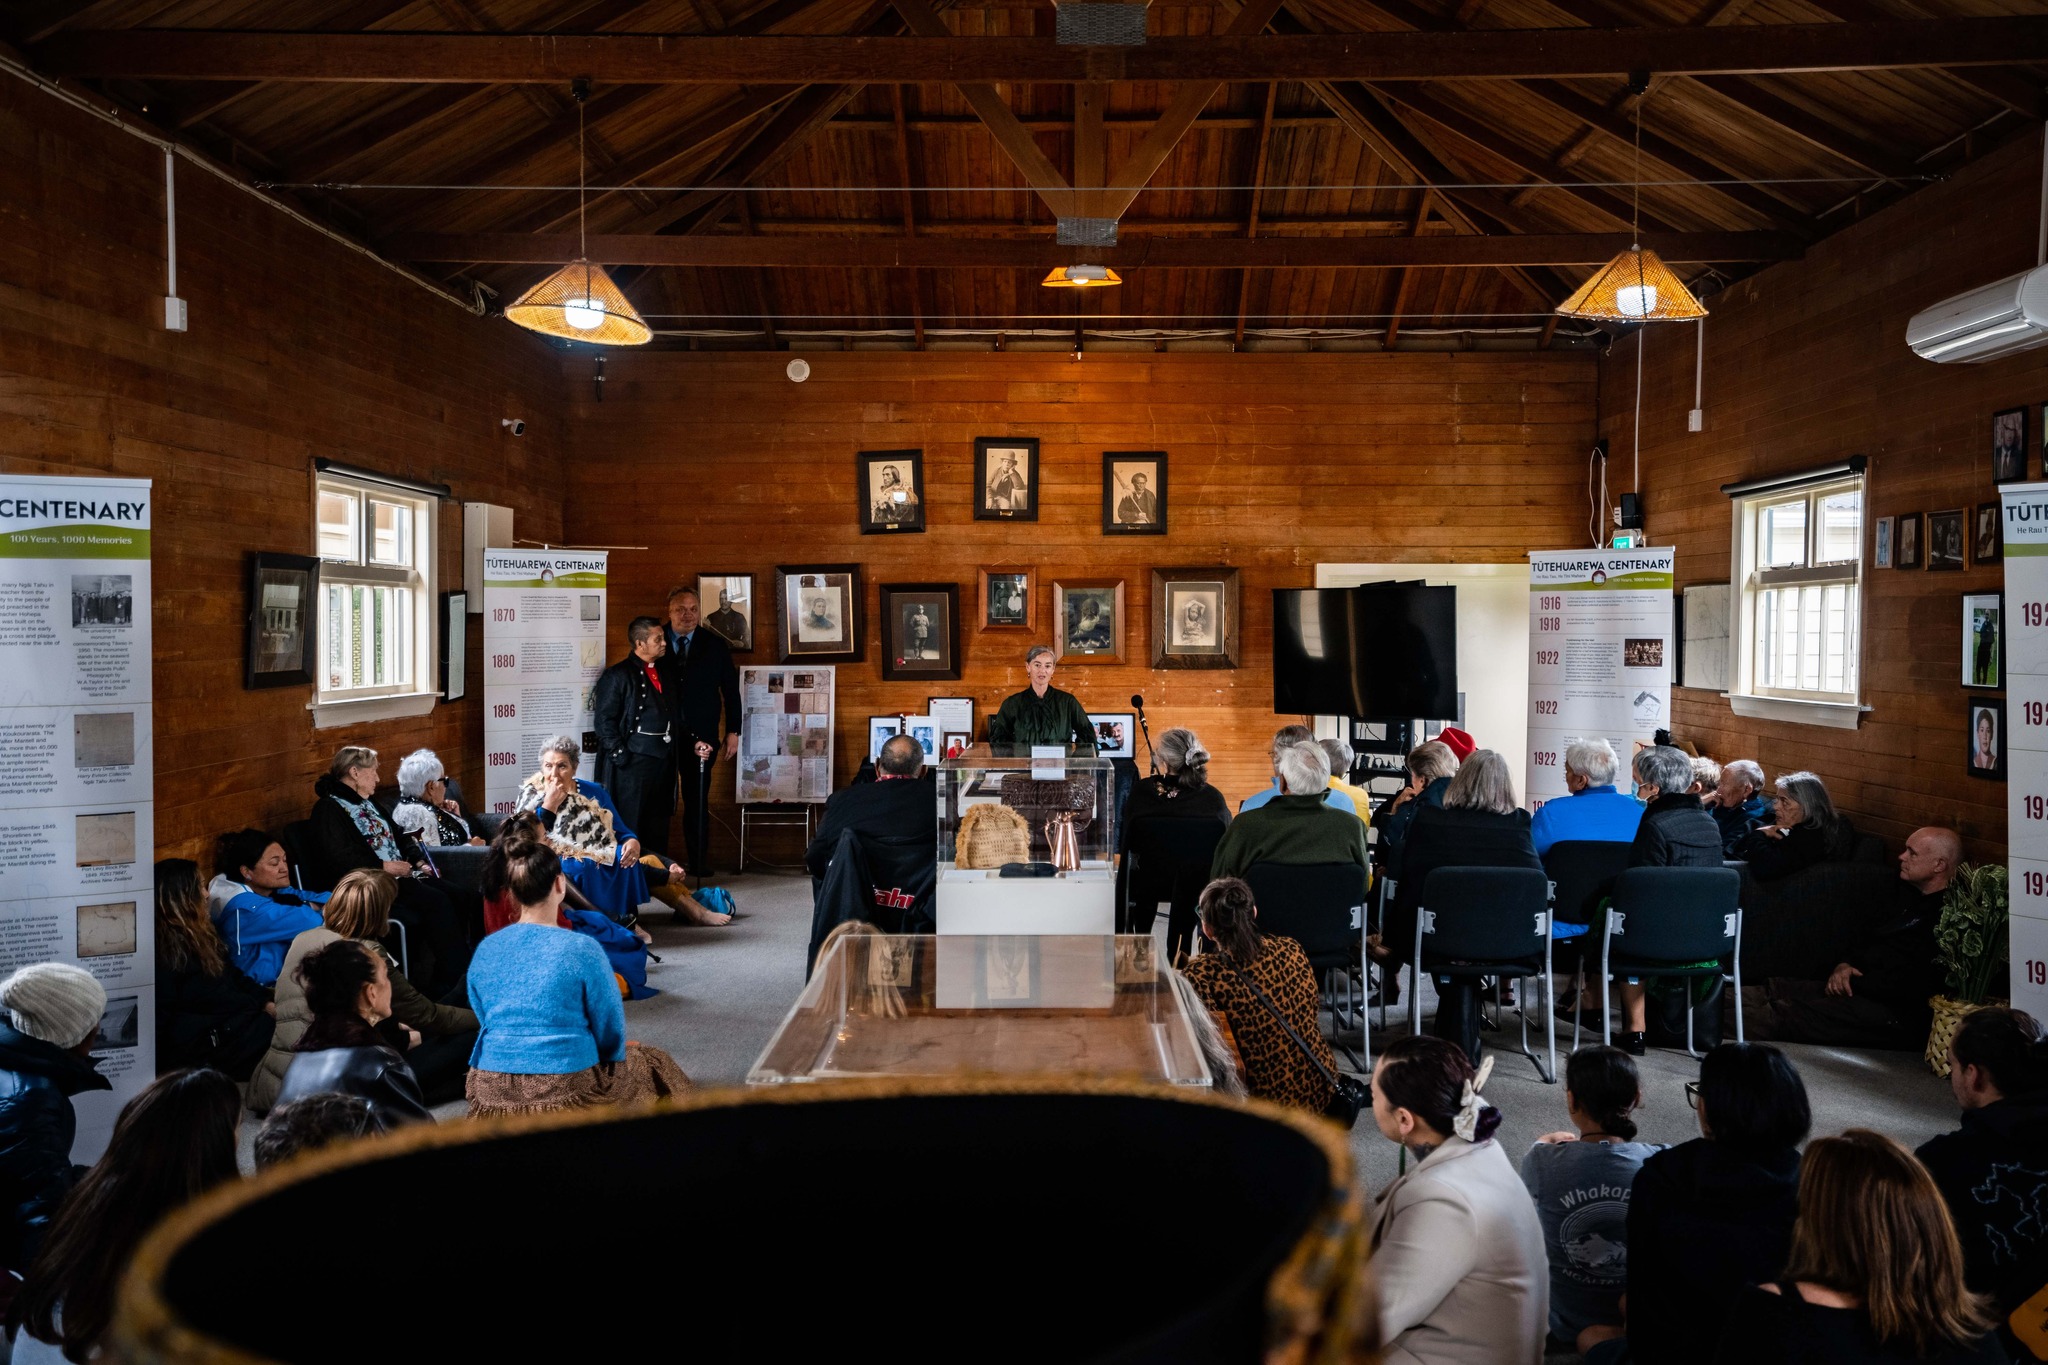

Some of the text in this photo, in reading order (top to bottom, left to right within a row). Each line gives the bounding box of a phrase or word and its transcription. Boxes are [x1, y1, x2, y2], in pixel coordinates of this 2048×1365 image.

[0, 499, 145, 520] CENTENARY
[10, 535, 132, 545] 100 Years, 1000 Memories
[486, 558, 604, 570] TŪTEHUAREWA CENTENARY
[1532, 559, 1670, 572] TŪTEHUAREWA CENTENARY
[1540, 596, 1560, 610] 1916
[492, 609, 515, 622] 1870
[2022, 602, 2048, 627] 19
[1539, 617, 1560, 631] 1918
[492, 654, 514, 668] 1880
[1536, 651, 1558, 664] 1922
[493, 704, 515, 718] 1886
[1535, 700, 1558, 714] 1922
[2023, 702, 2048, 726] 19
[488, 752, 516, 766] 1890s
[1534, 752, 1556, 766] 1922
[2024, 795, 2048, 820] 19
[2023, 871, 2048, 896] 19
